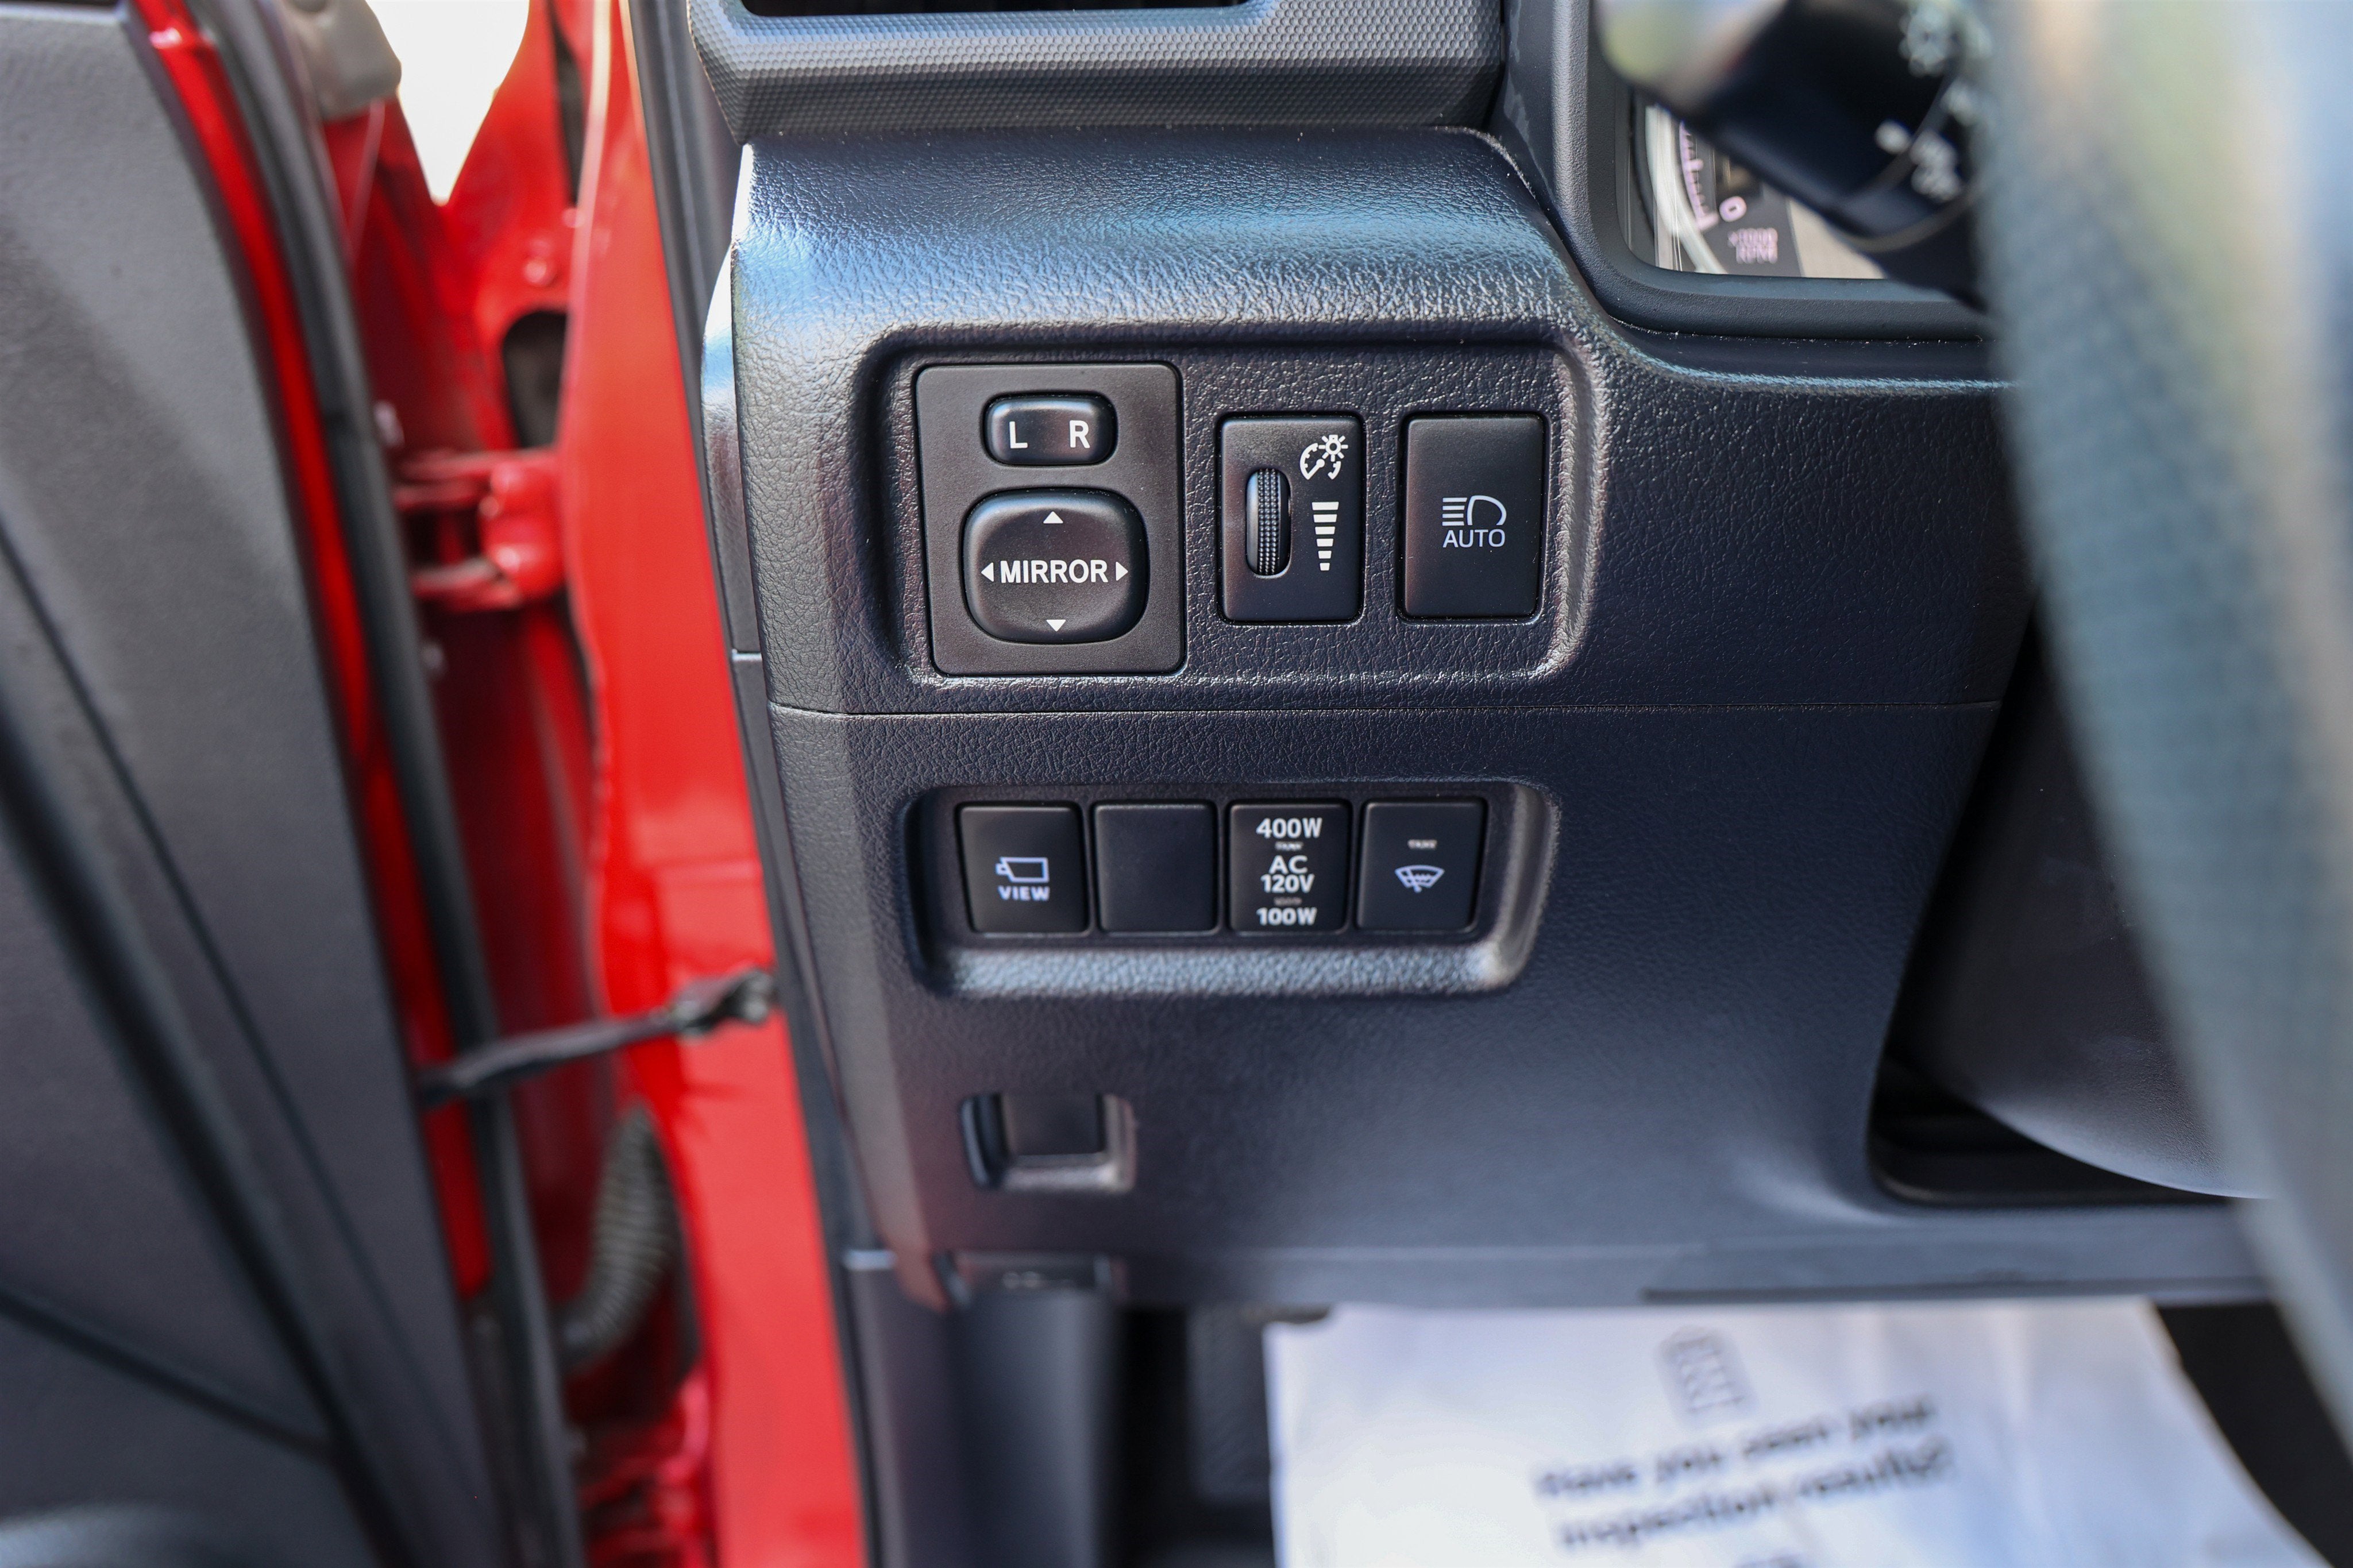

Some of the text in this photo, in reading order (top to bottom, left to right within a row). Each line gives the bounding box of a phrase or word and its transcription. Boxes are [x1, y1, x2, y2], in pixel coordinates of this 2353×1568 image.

[1009, 420, 1090, 449] L R
[1442, 528, 1506, 548] AUTO
[1000, 559, 1109, 584] MIRROR
[1256, 817, 1322, 839] 400W
[1268, 855, 1308, 874] AC
[997, 885, 1050, 901] VIEW
[1260, 874, 1315, 893] 120V
[1256, 907, 1317, 925] 100W
